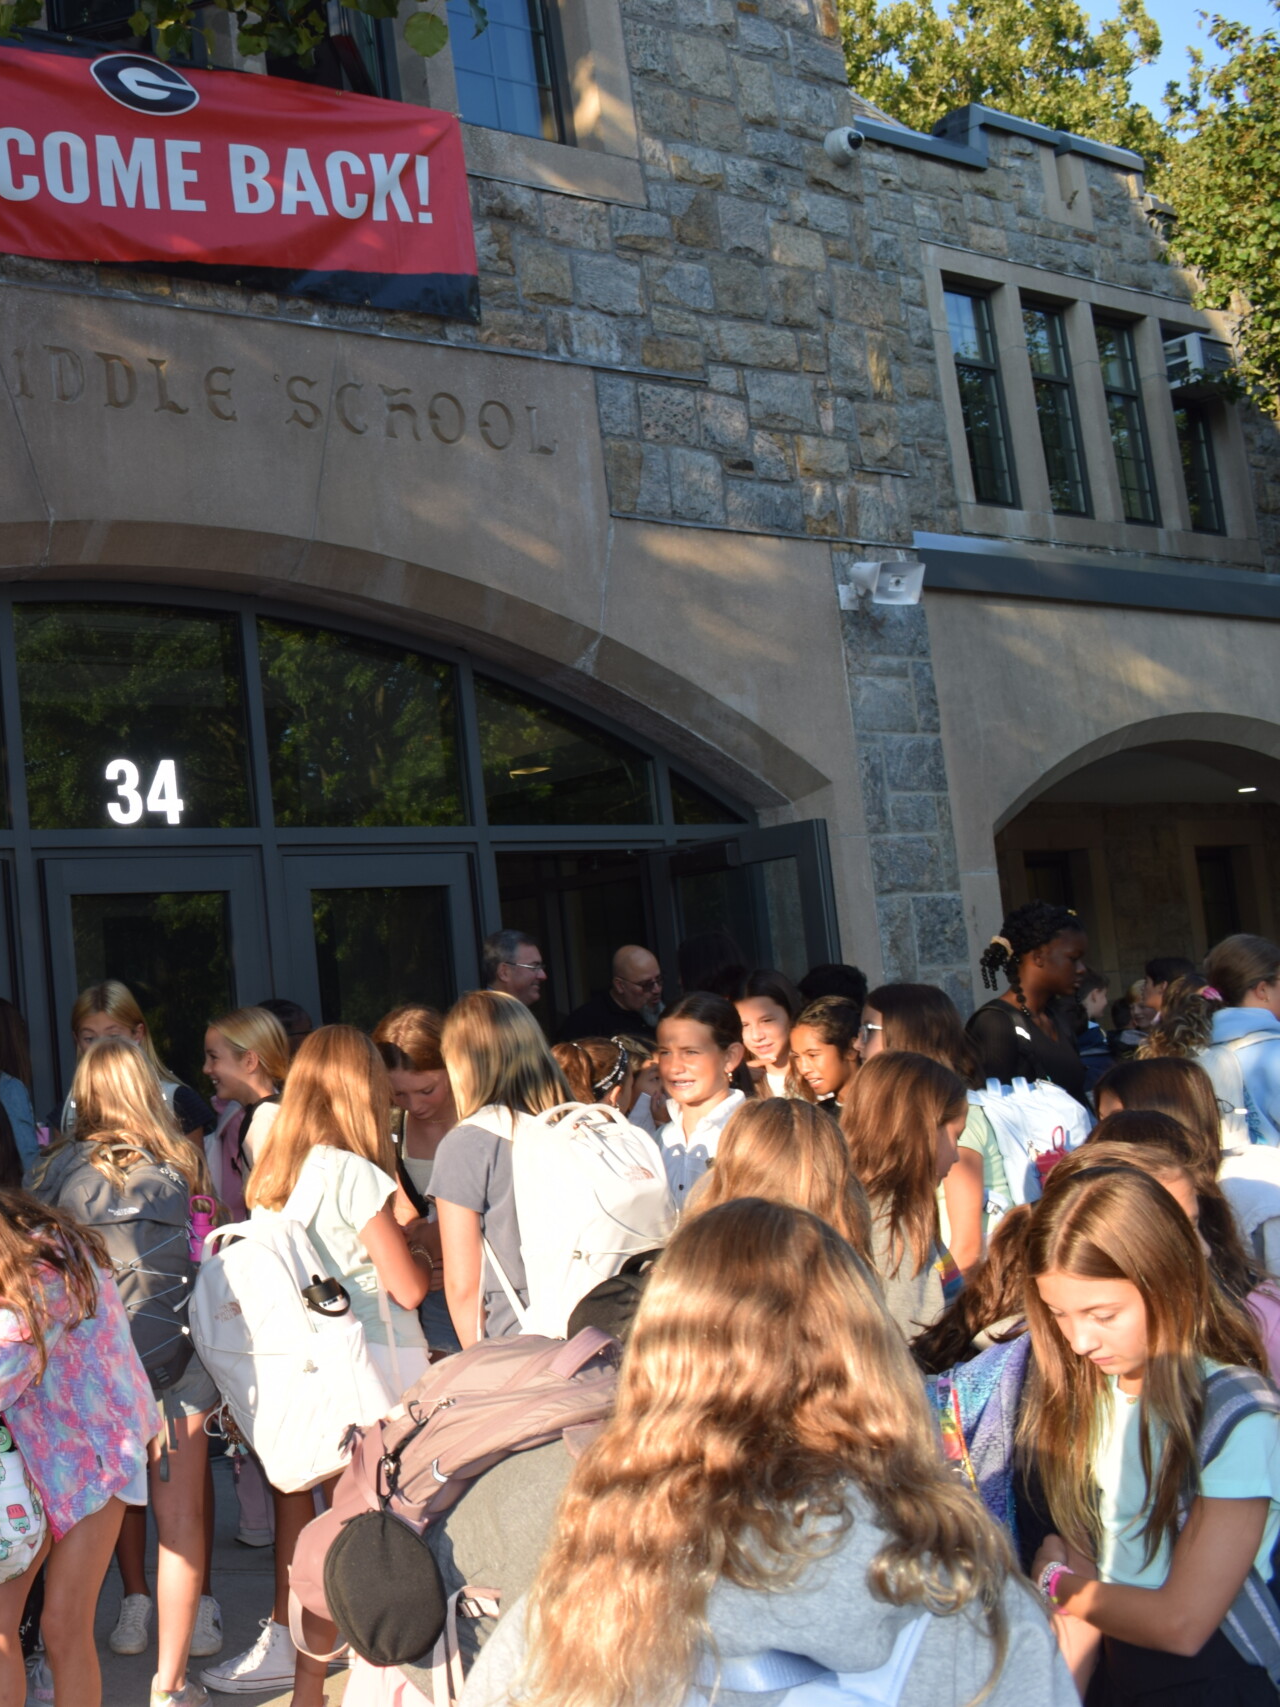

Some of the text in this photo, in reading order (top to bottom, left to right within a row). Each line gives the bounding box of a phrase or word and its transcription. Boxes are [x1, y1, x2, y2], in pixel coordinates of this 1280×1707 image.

[228, 142, 434, 225] BACK!
[284, 374, 560, 456] SCHOOL
[105, 758, 184, 825] 34
